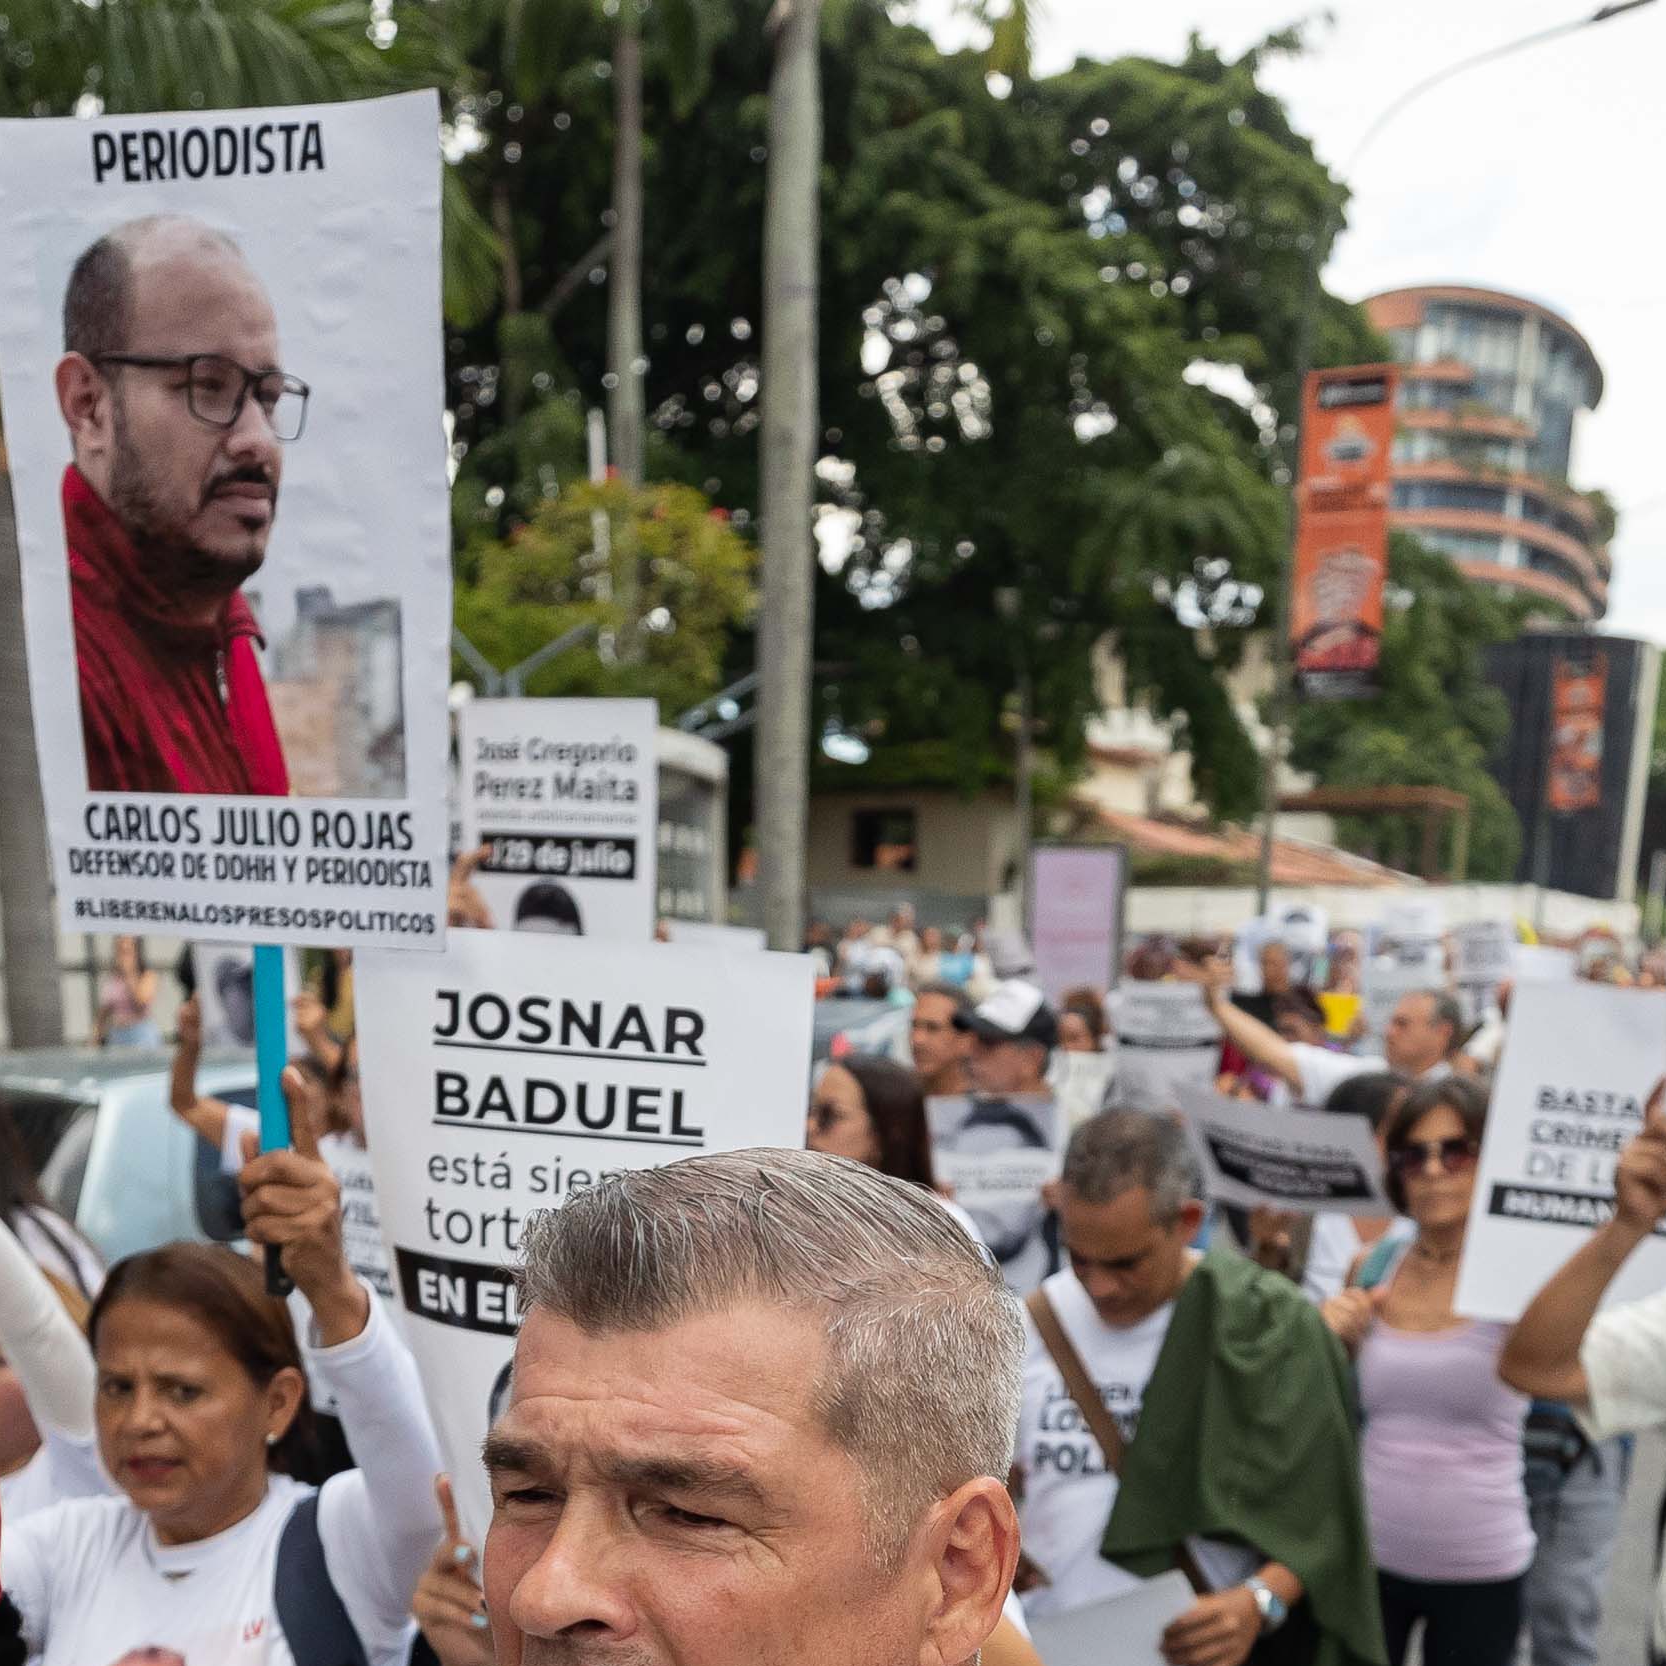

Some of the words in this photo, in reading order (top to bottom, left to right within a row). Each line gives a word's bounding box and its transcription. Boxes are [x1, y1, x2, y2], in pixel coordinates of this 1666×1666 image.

[91, 121, 326, 184] PERIODISTA
[84, 802, 201, 845] CARLOS
[211, 806, 301, 848] JULIO
[312, 810, 414, 851] ROJAS
[68, 848, 175, 879] DEFENSOR
[182, 851, 209, 880] DE
[215, 853, 276, 883] DDHH
[284, 857, 298, 883] Y
[306, 857, 432, 889] PERIODISTA
[73, 897, 436, 935] #LIBERENALOSPRESOSPOLITICOS
[434, 989, 706, 1057] JOSNAR
[435, 1071, 704, 1138] BADUEL
[1538, 1084, 1642, 1119] BASTA
[428, 1151, 512, 1191] está
[424, 1197, 521, 1252] tort
[416, 1269, 467, 1319] EN
